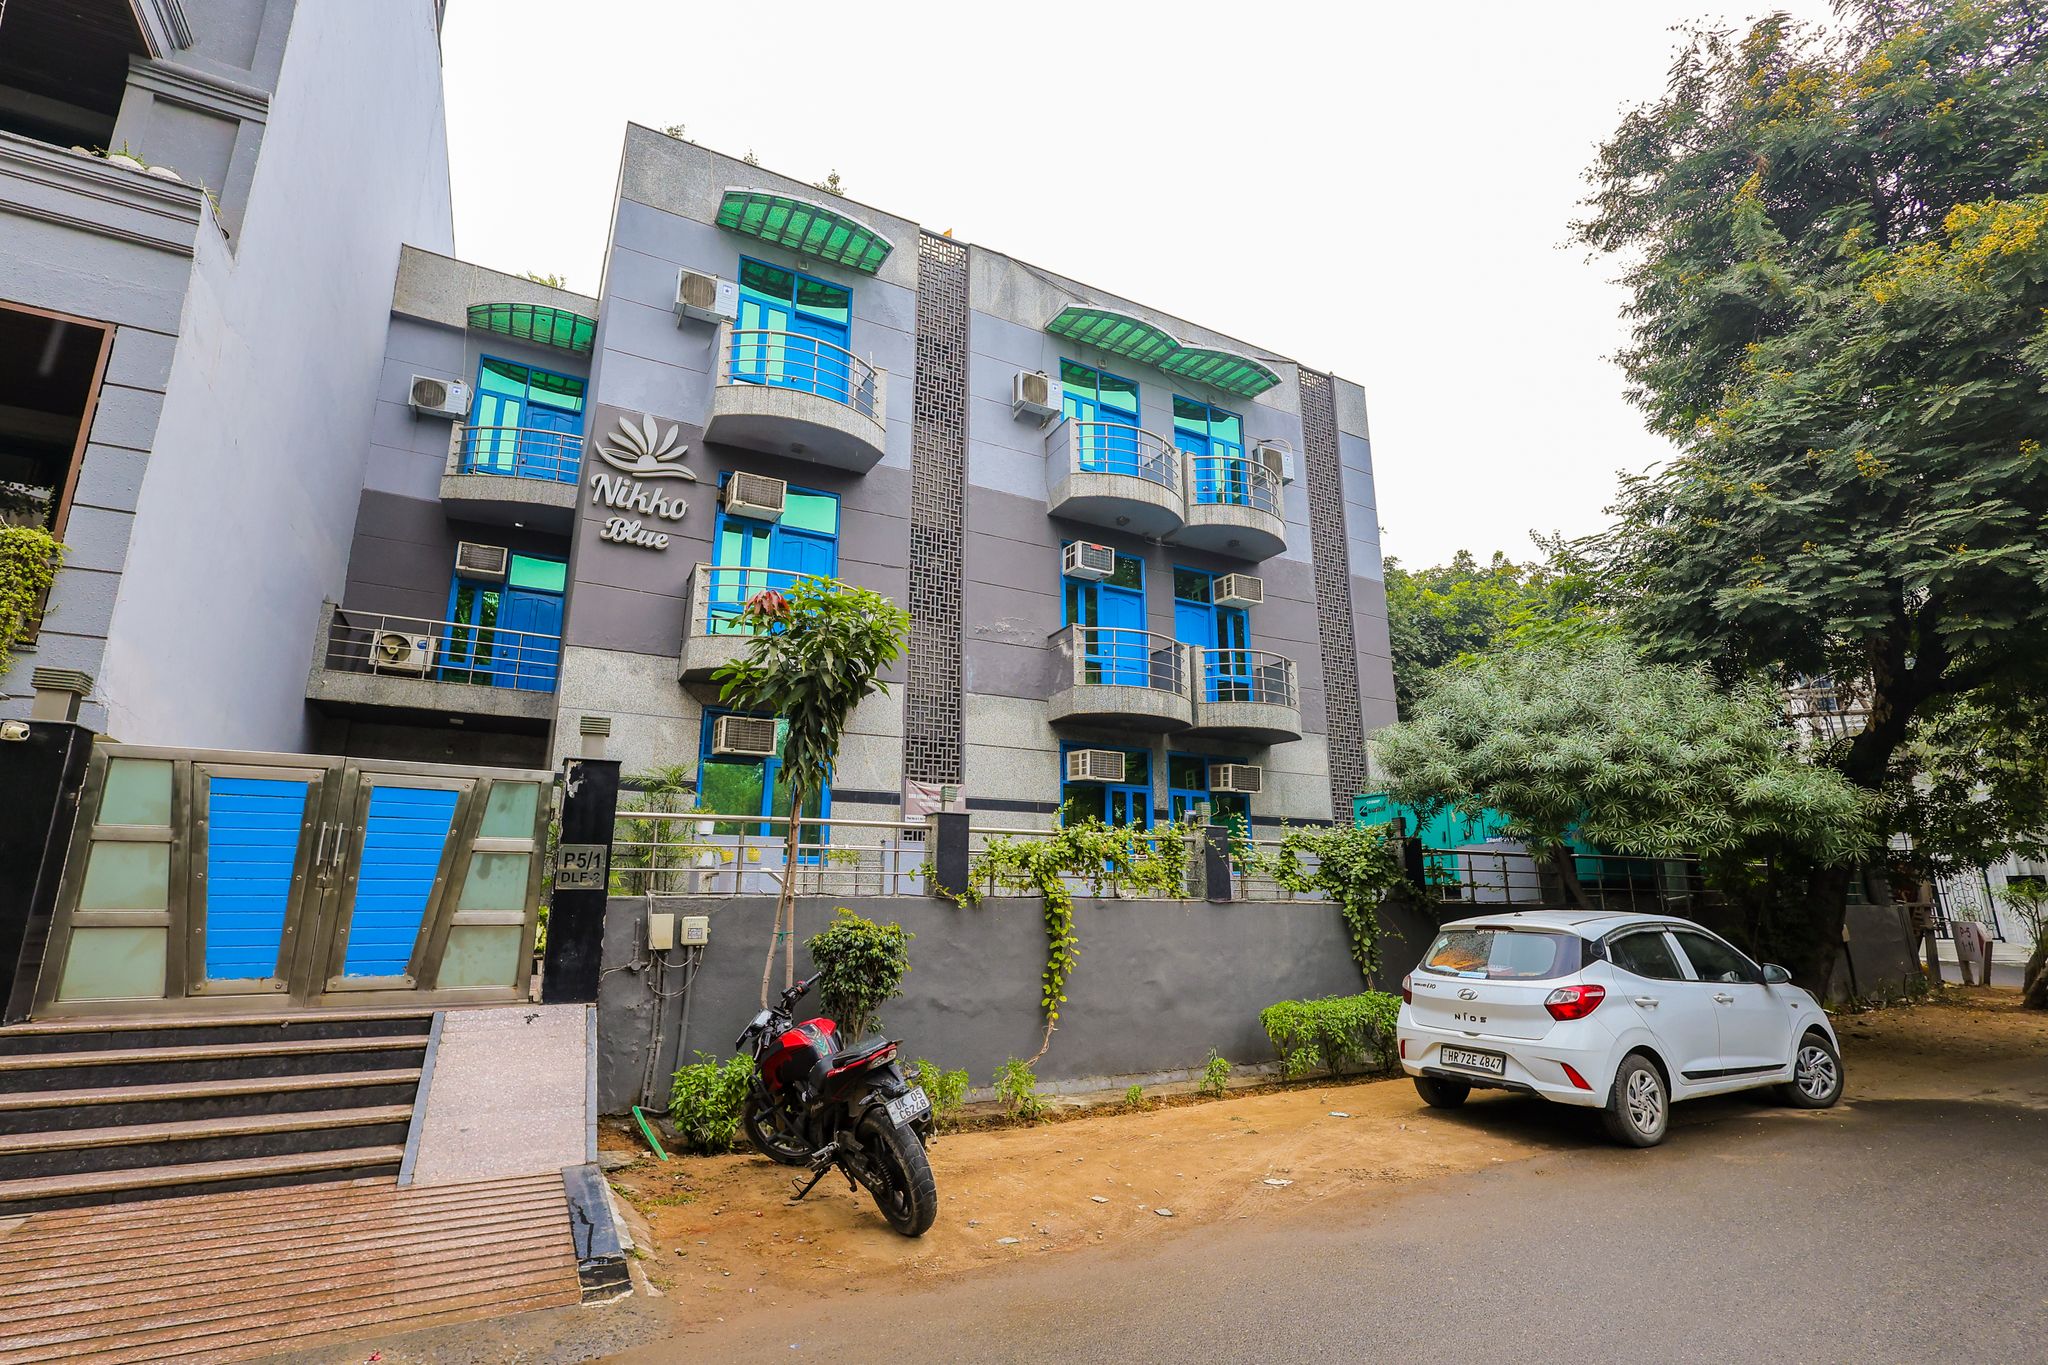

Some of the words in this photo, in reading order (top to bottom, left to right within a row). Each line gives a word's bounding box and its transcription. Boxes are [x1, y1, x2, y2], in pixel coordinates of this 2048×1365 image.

[590, 473, 689, 521] Nikko
[600, 516, 669, 550] Blue
[564, 851, 601, 870] P5/1
[1448, 1050, 1459, 1063] HR
[1461, 1053, 1478, 1066] 72E
[1479, 1056, 1502, 1069] 4847
[894, 1097, 907, 1110] UK
[910, 1089, 923, 1102] 05
[899, 1098, 927, 1120] C6248
